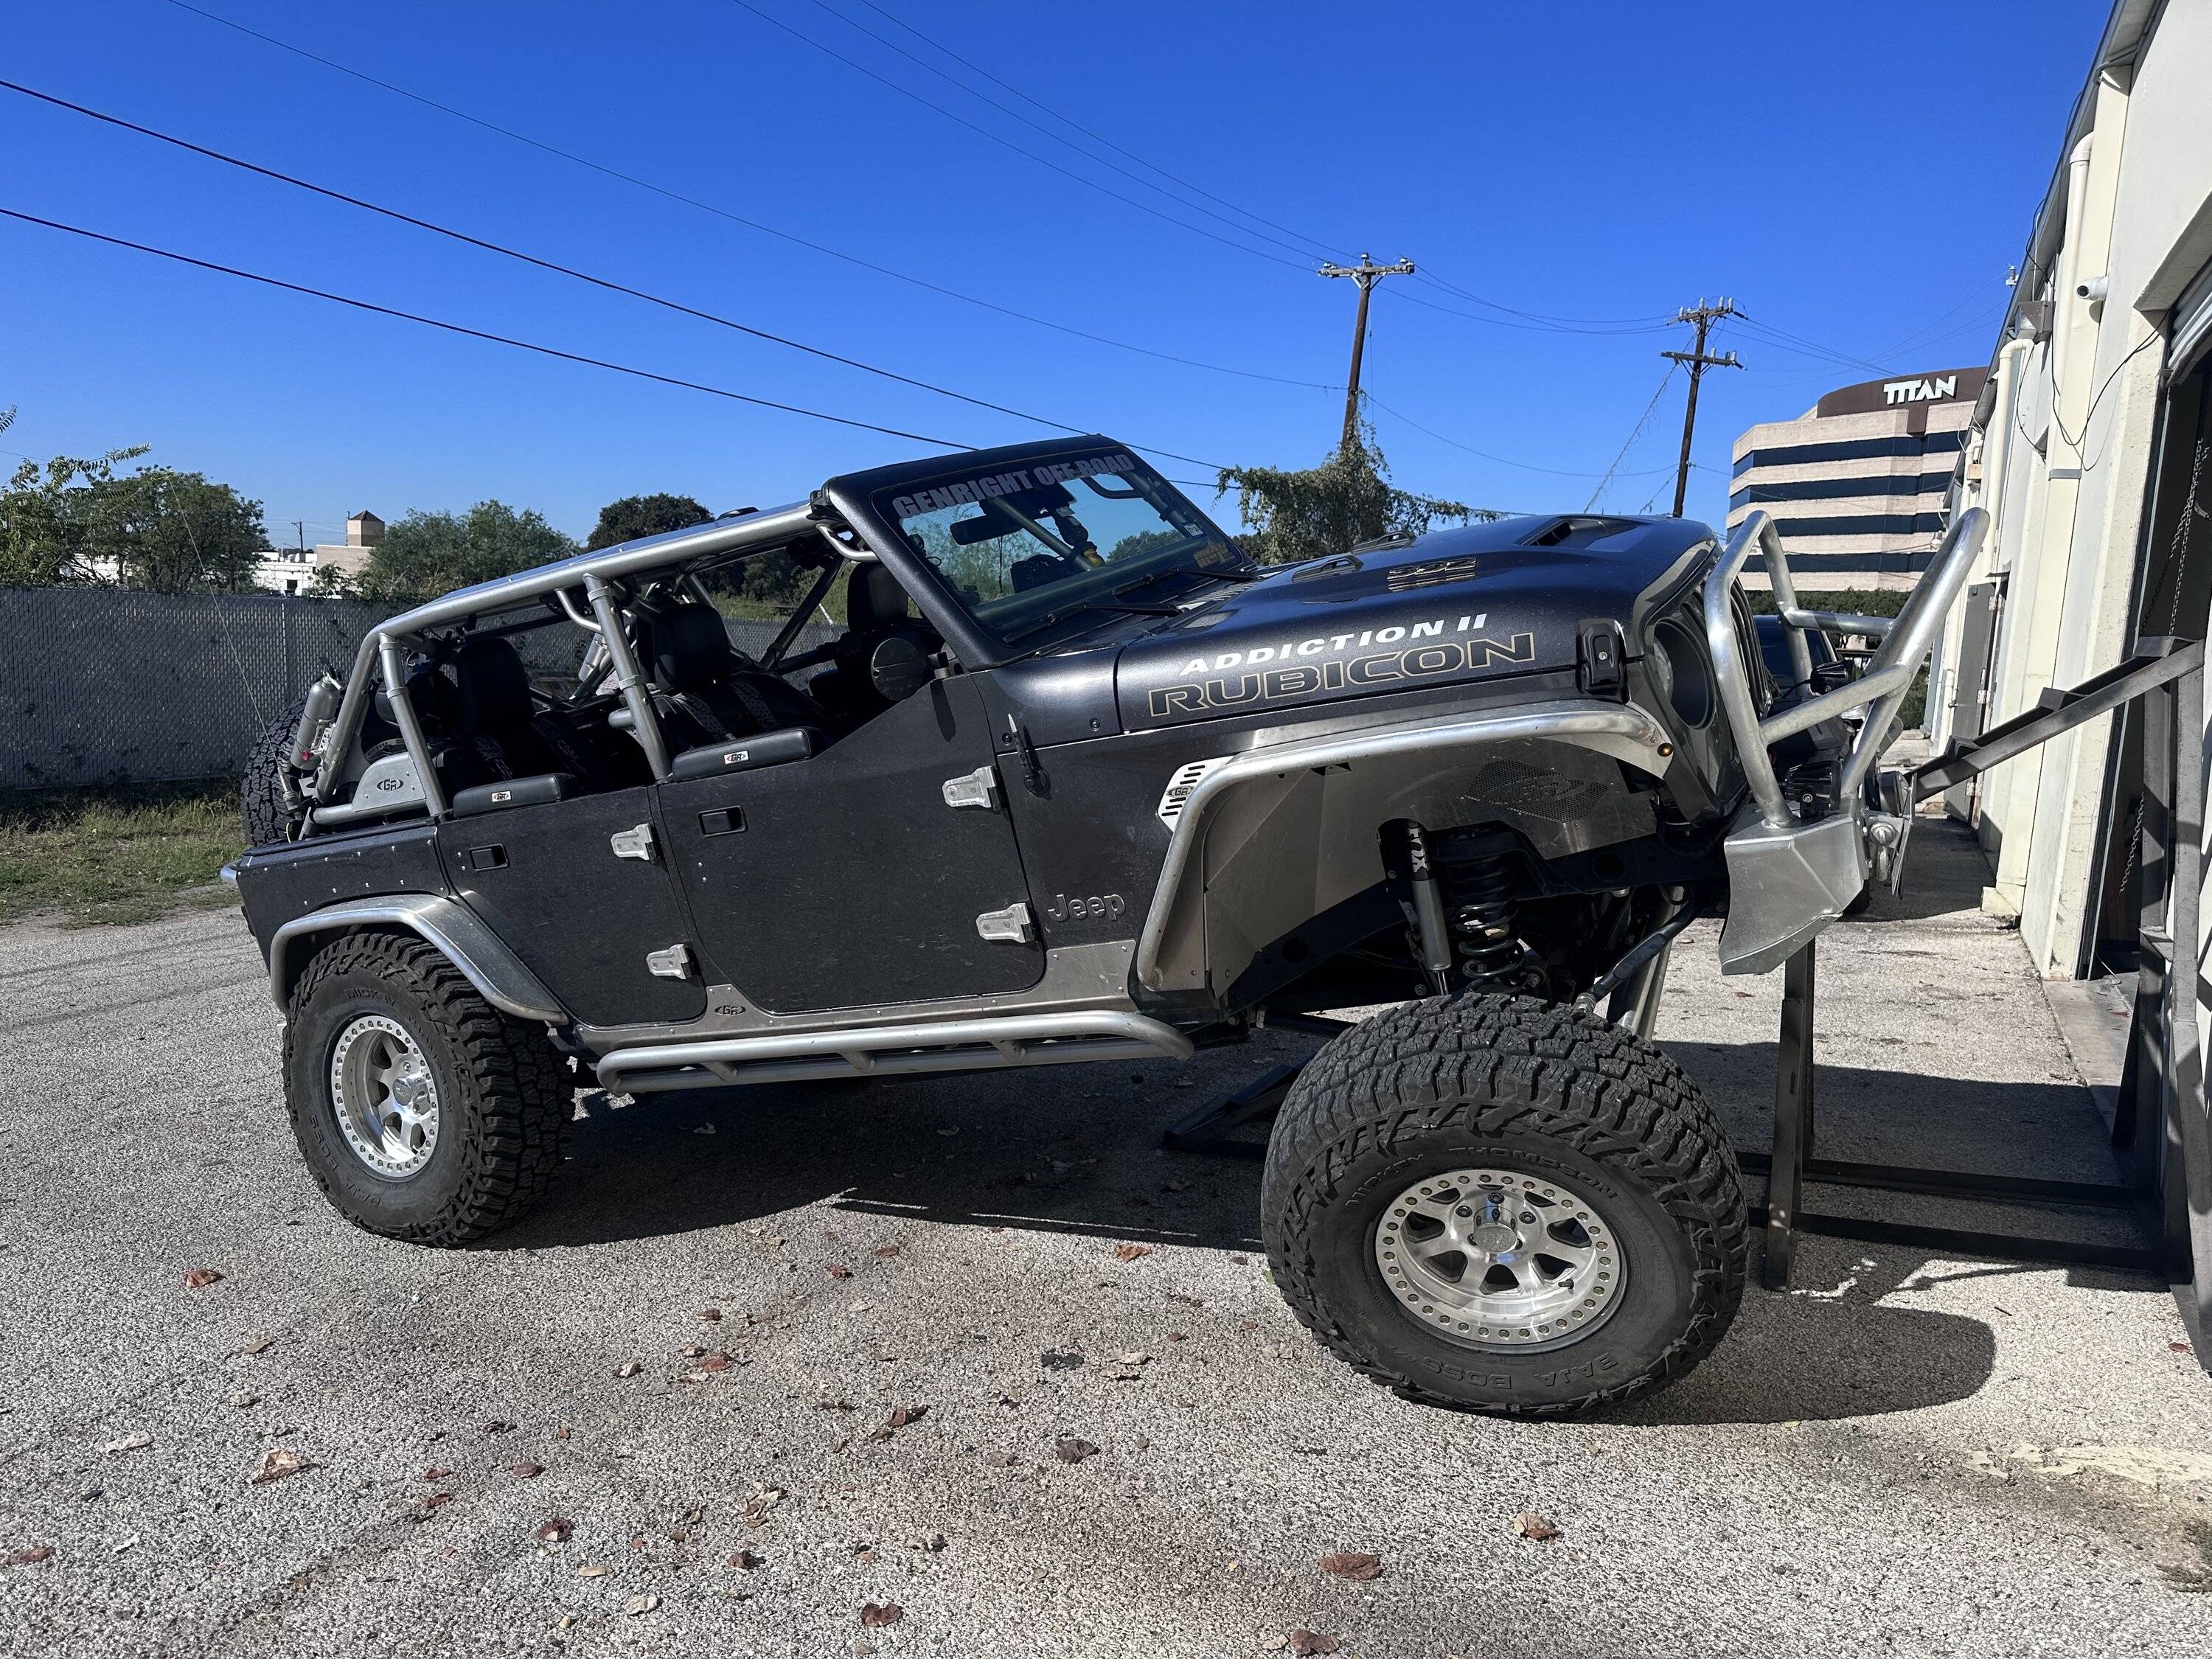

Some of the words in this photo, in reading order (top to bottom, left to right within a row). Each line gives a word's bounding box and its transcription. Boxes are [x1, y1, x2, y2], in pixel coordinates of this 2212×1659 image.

[1883, 375, 1957, 405] TITAN
[891, 470, 1034, 517] GENRIGHT
[1074, 454, 1135, 478] ROAD
[1179, 619, 1445, 676] ADDICTION
[1147, 632, 1536, 717] RUBICON
[1408, 827, 1428, 873] FOX
[1047, 893, 1126, 922] Jeep
[1447, 1146, 1619, 1201] THOMPSON
[1421, 1355, 1512, 1390] BOSS
